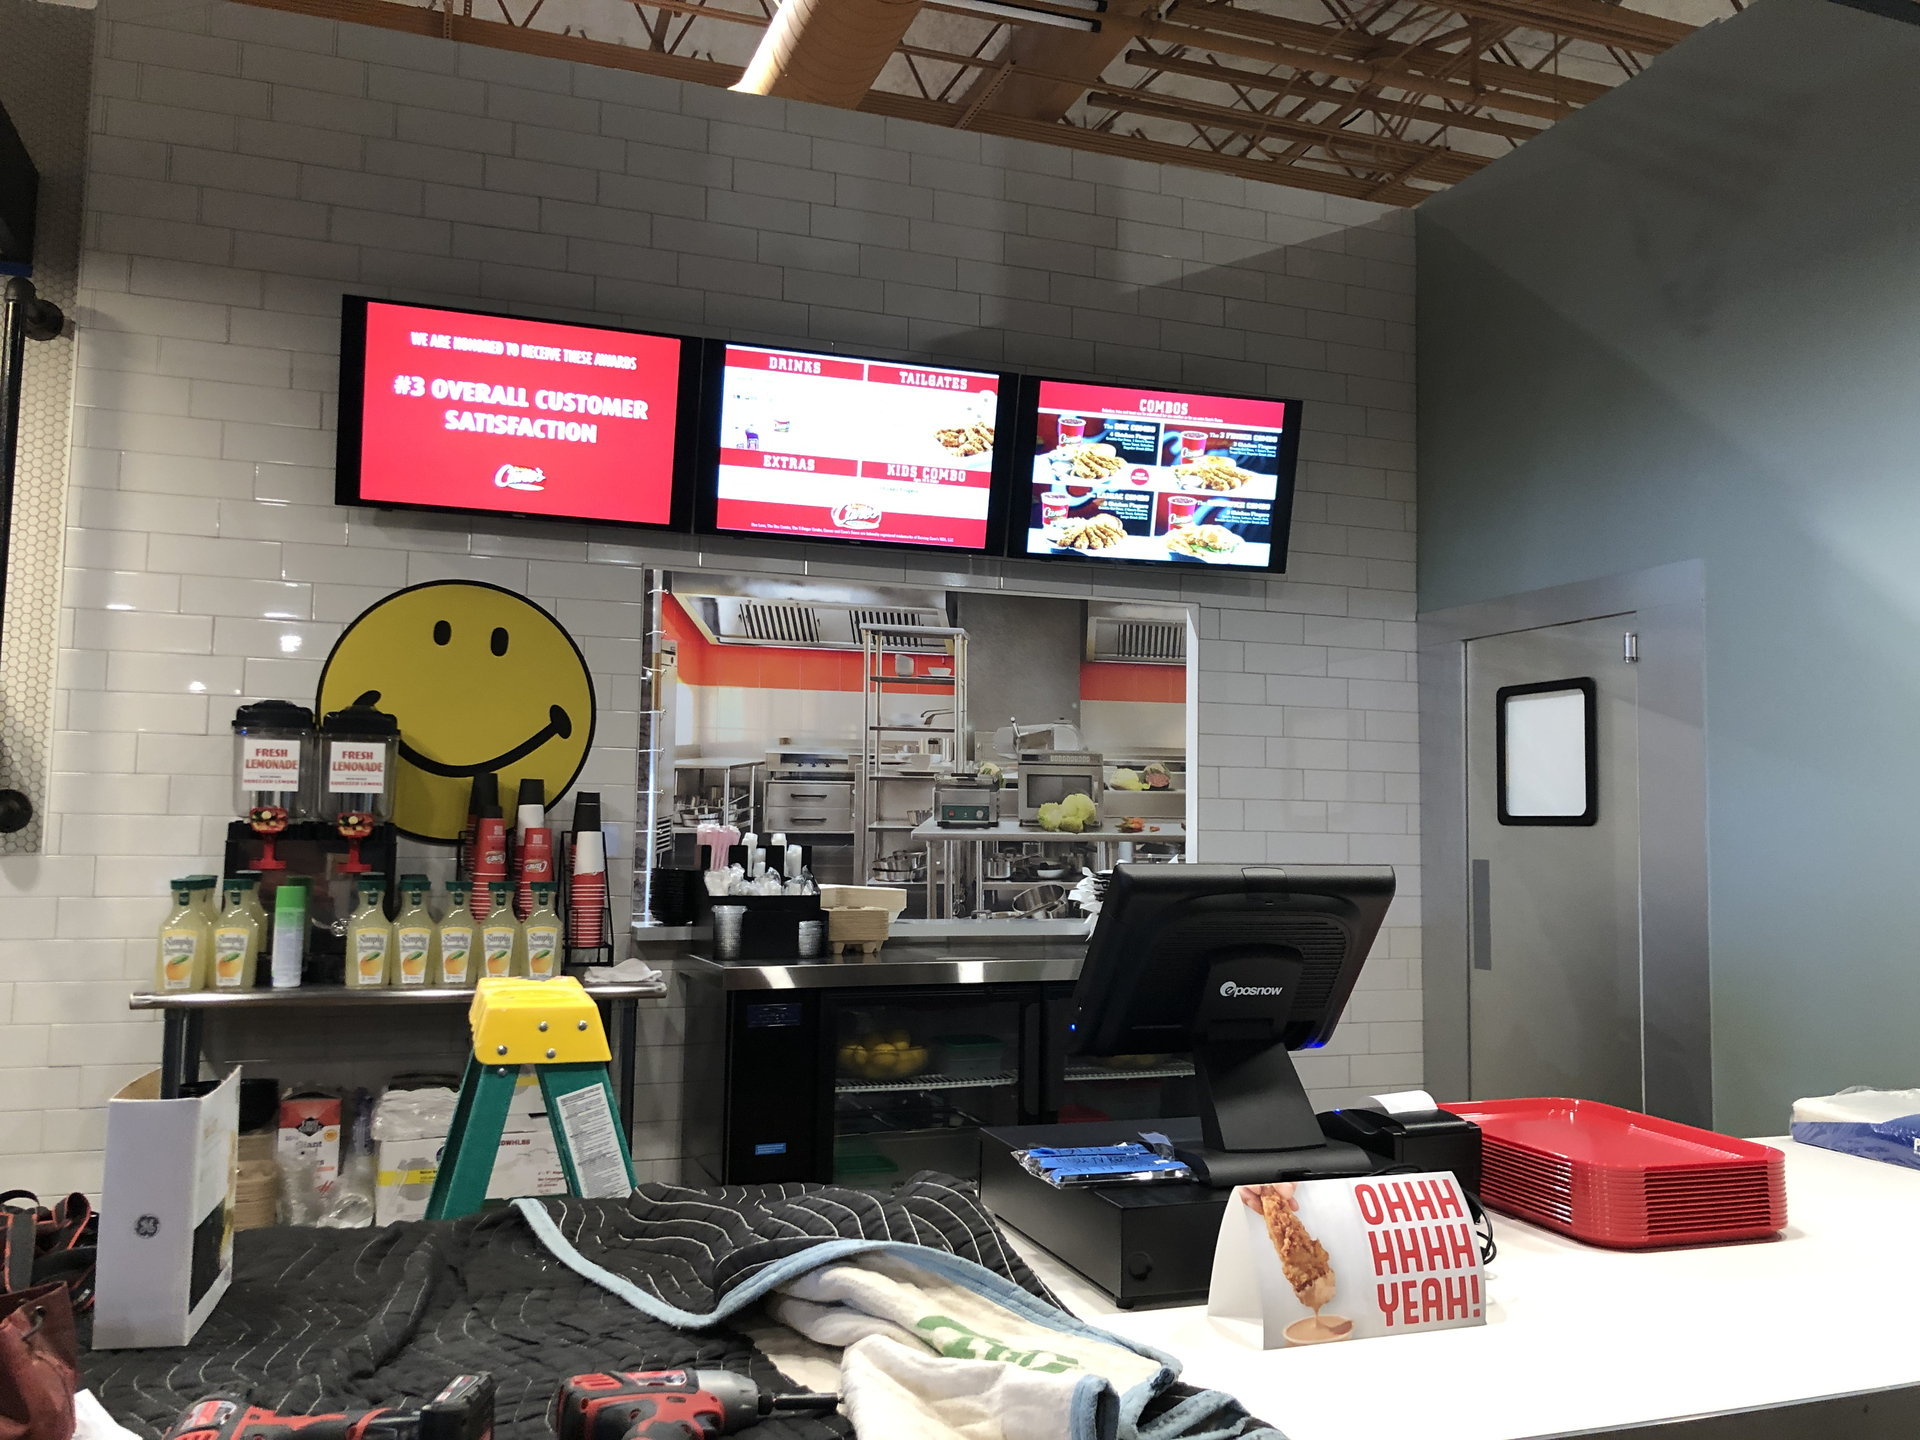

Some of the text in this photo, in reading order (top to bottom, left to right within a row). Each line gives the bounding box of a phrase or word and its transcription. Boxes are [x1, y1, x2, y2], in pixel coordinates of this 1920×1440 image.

[410, 331, 638, 370] WE ARE HONORED TO RECEIVE THESE AWARDS
[768, 356, 821, 375] DRINKS
[899, 371, 968, 391] TAILGATES
[393, 375, 649, 420] #3 OVERALL CUSTOMER
[1139, 399, 1189, 416] COMBOS
[444, 409, 598, 444] SATISFACTION
[763, 454, 815, 473] EXTRAS
[886, 463, 918, 478] KIDS
[922, 467, 967, 483] COMBO
[255, 748, 288, 758] FRESH
[341, 751, 374, 760] FRESH
[245, 760, 299, 770] LEMONADE
[331, 761, 384, 772] LEMONADE
[359, 934, 385, 946] Simply
[401, 934, 428, 946] Simply
[443, 934, 469, 945] Simply
[486, 934, 511, 945] Simply
[528, 934, 553, 945] Simply
[1354, 1179, 1464, 1225] OHHH
[1368, 1223, 1476, 1276] HHHH
[1377, 1275, 1480, 1327] YEAH!
